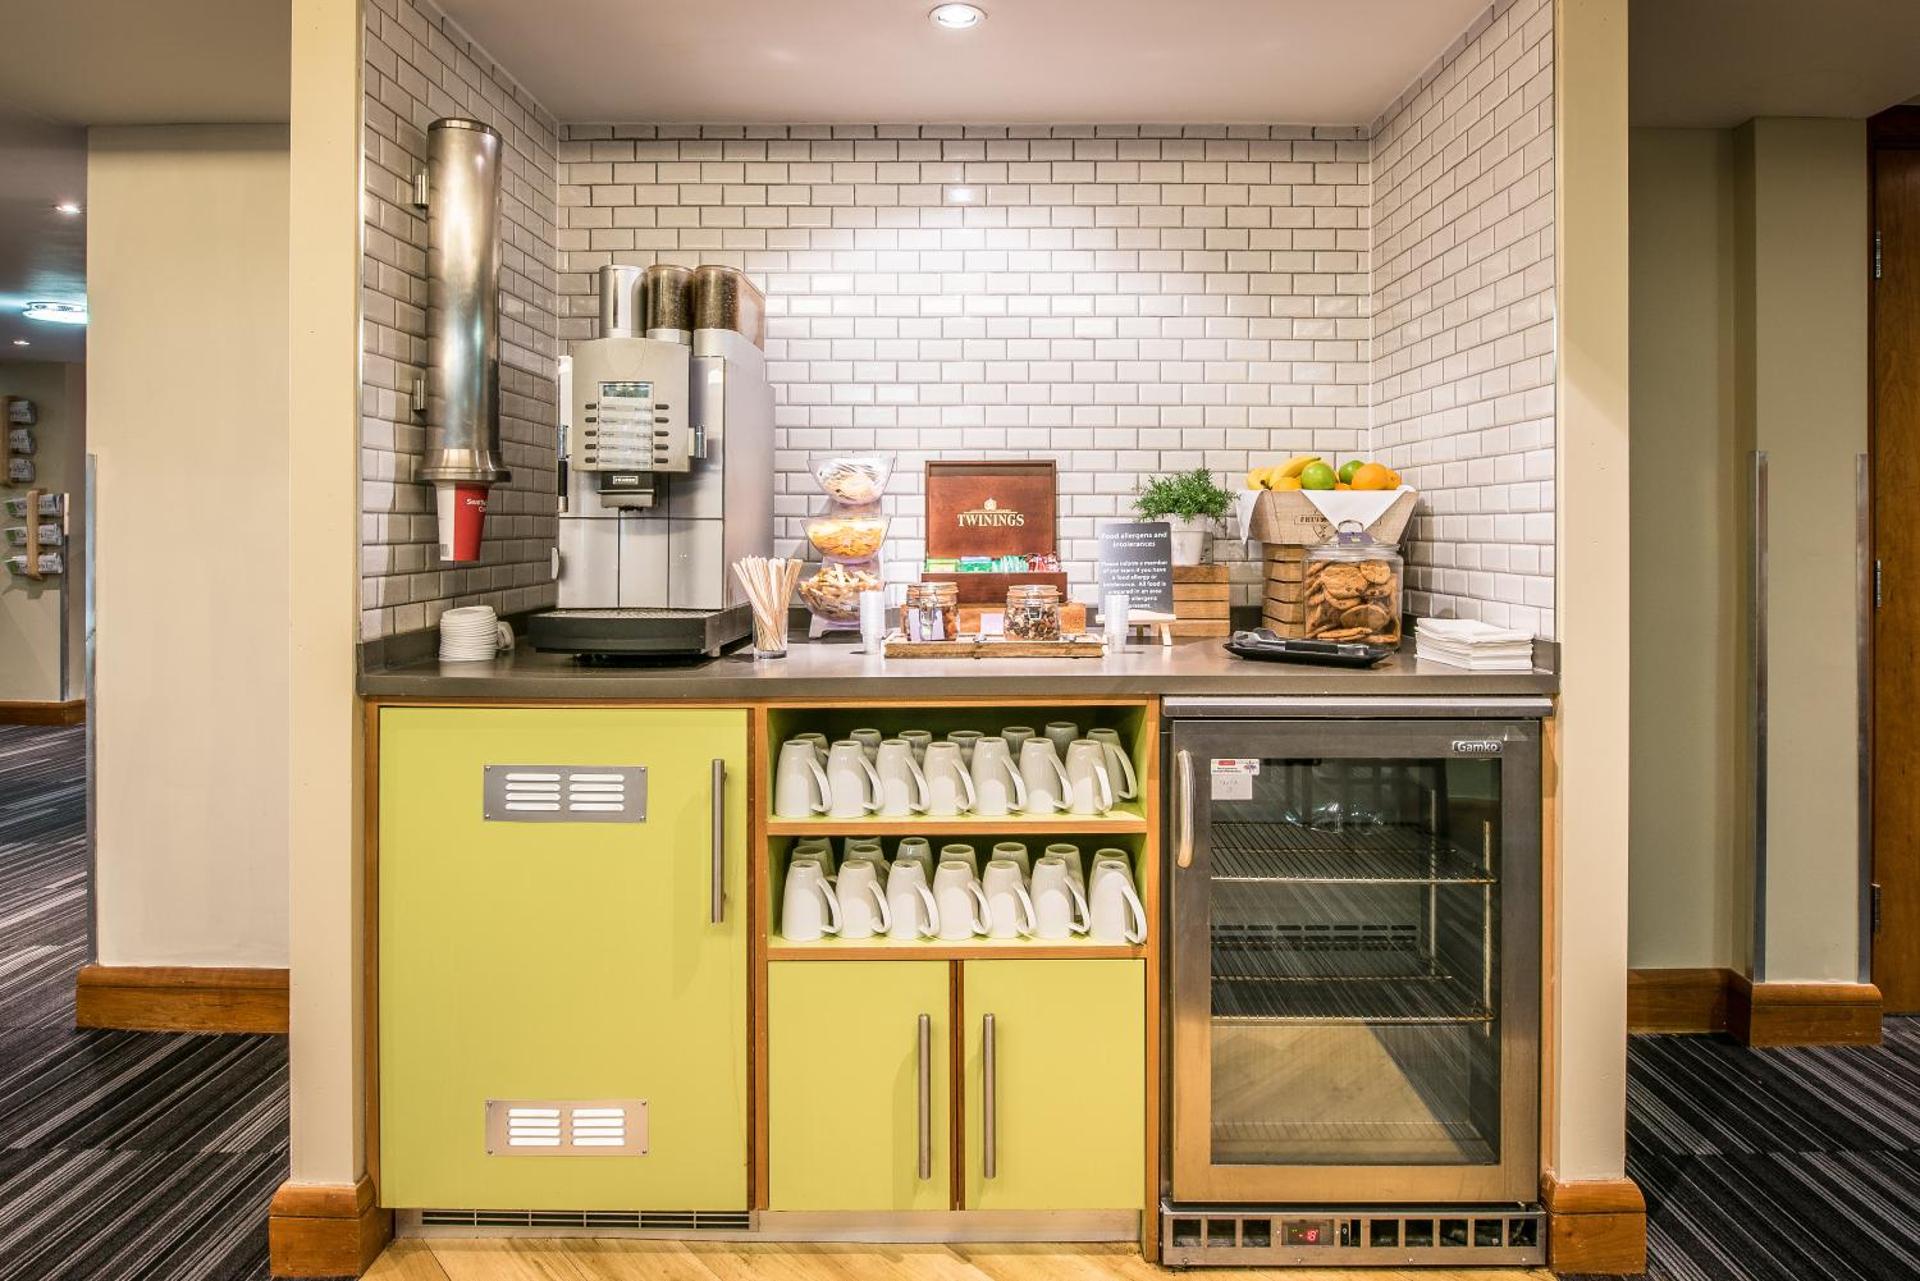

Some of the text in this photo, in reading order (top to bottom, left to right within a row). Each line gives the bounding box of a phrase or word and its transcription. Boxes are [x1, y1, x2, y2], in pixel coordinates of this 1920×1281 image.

[957, 513, 1025, 527] TWININGS
[1120, 532, 1152, 540] allergens
[1457, 740, 1497, 752] Gamko
